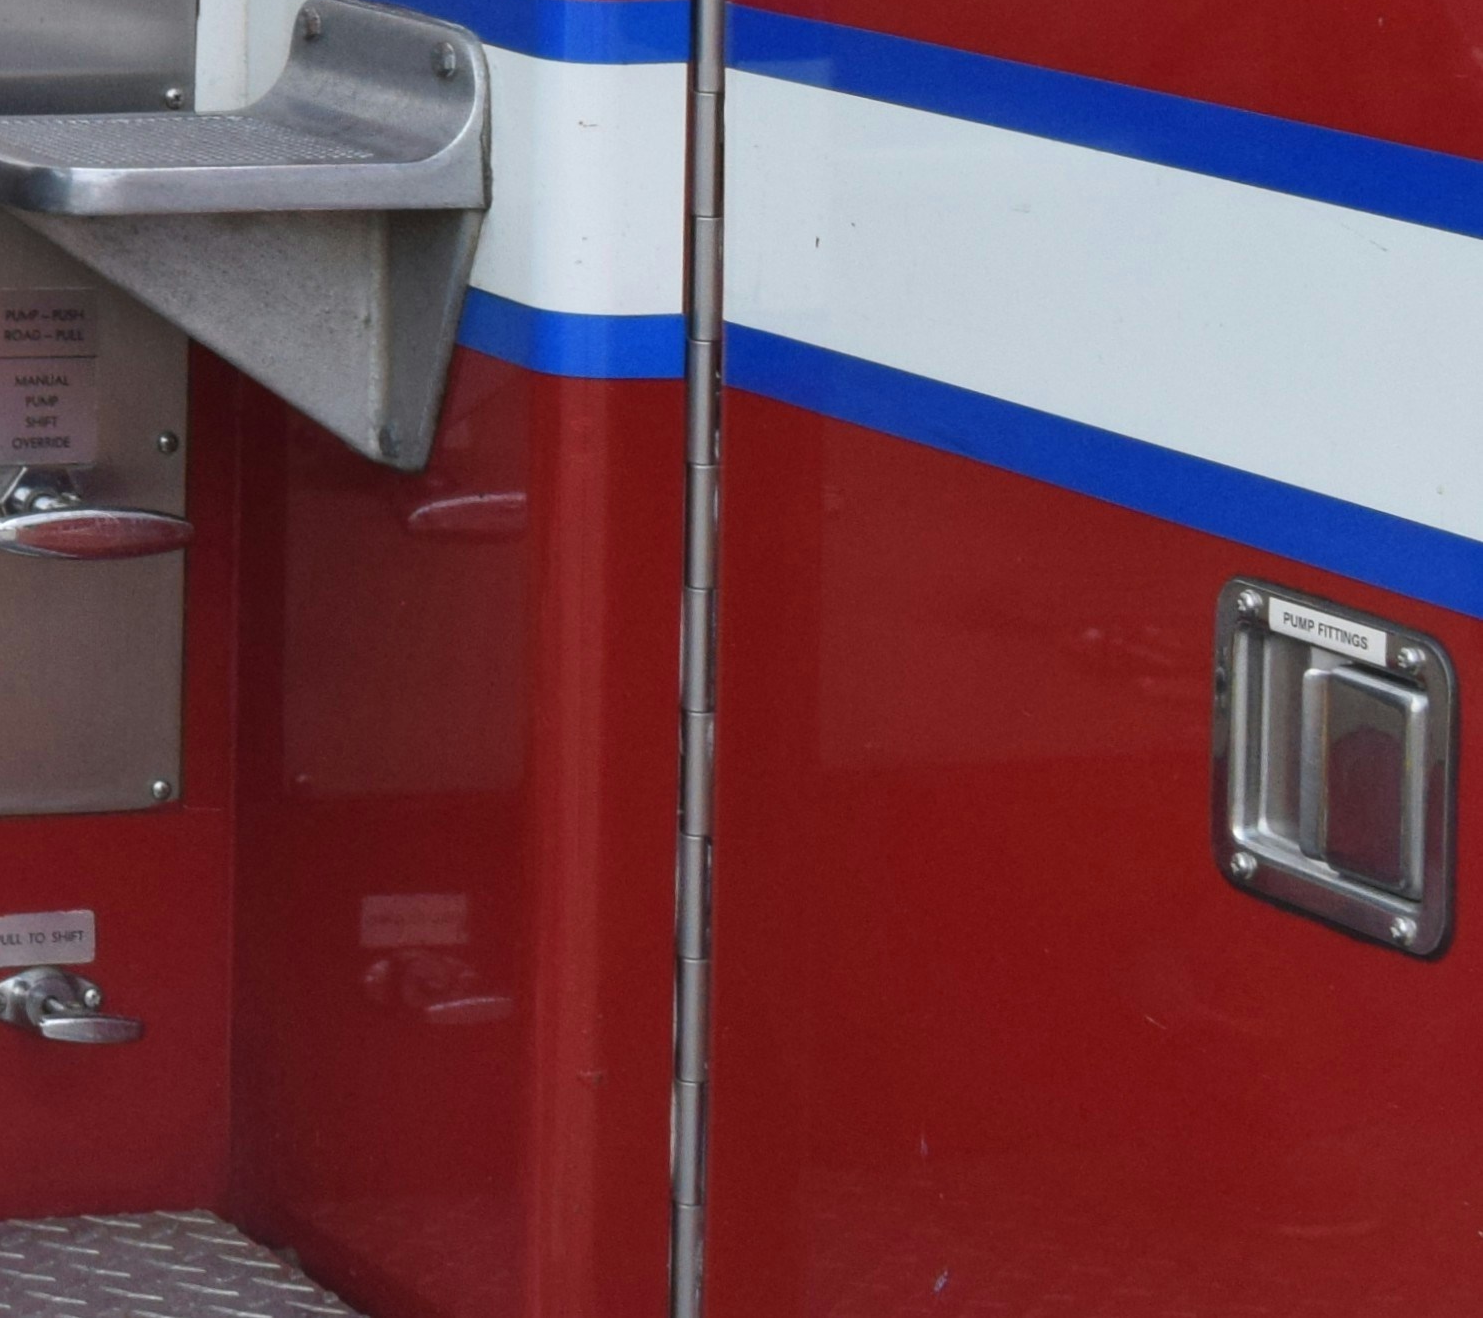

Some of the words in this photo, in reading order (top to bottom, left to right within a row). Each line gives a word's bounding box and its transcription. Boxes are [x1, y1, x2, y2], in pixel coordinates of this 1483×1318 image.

[15, 375, 70, 386] MANUAL
[25, 396, 59, 407] PUMP
[25, 417, 57, 428] SHIFT
[12, 437, 70, 449] OVERRIDE
[1283, 613, 1314, 632] PUMP
[1318, 623, 1368, 649] FITTINGS
[28, 931, 45, 946] TO
[51, 930, 84, 944] SHIFT
